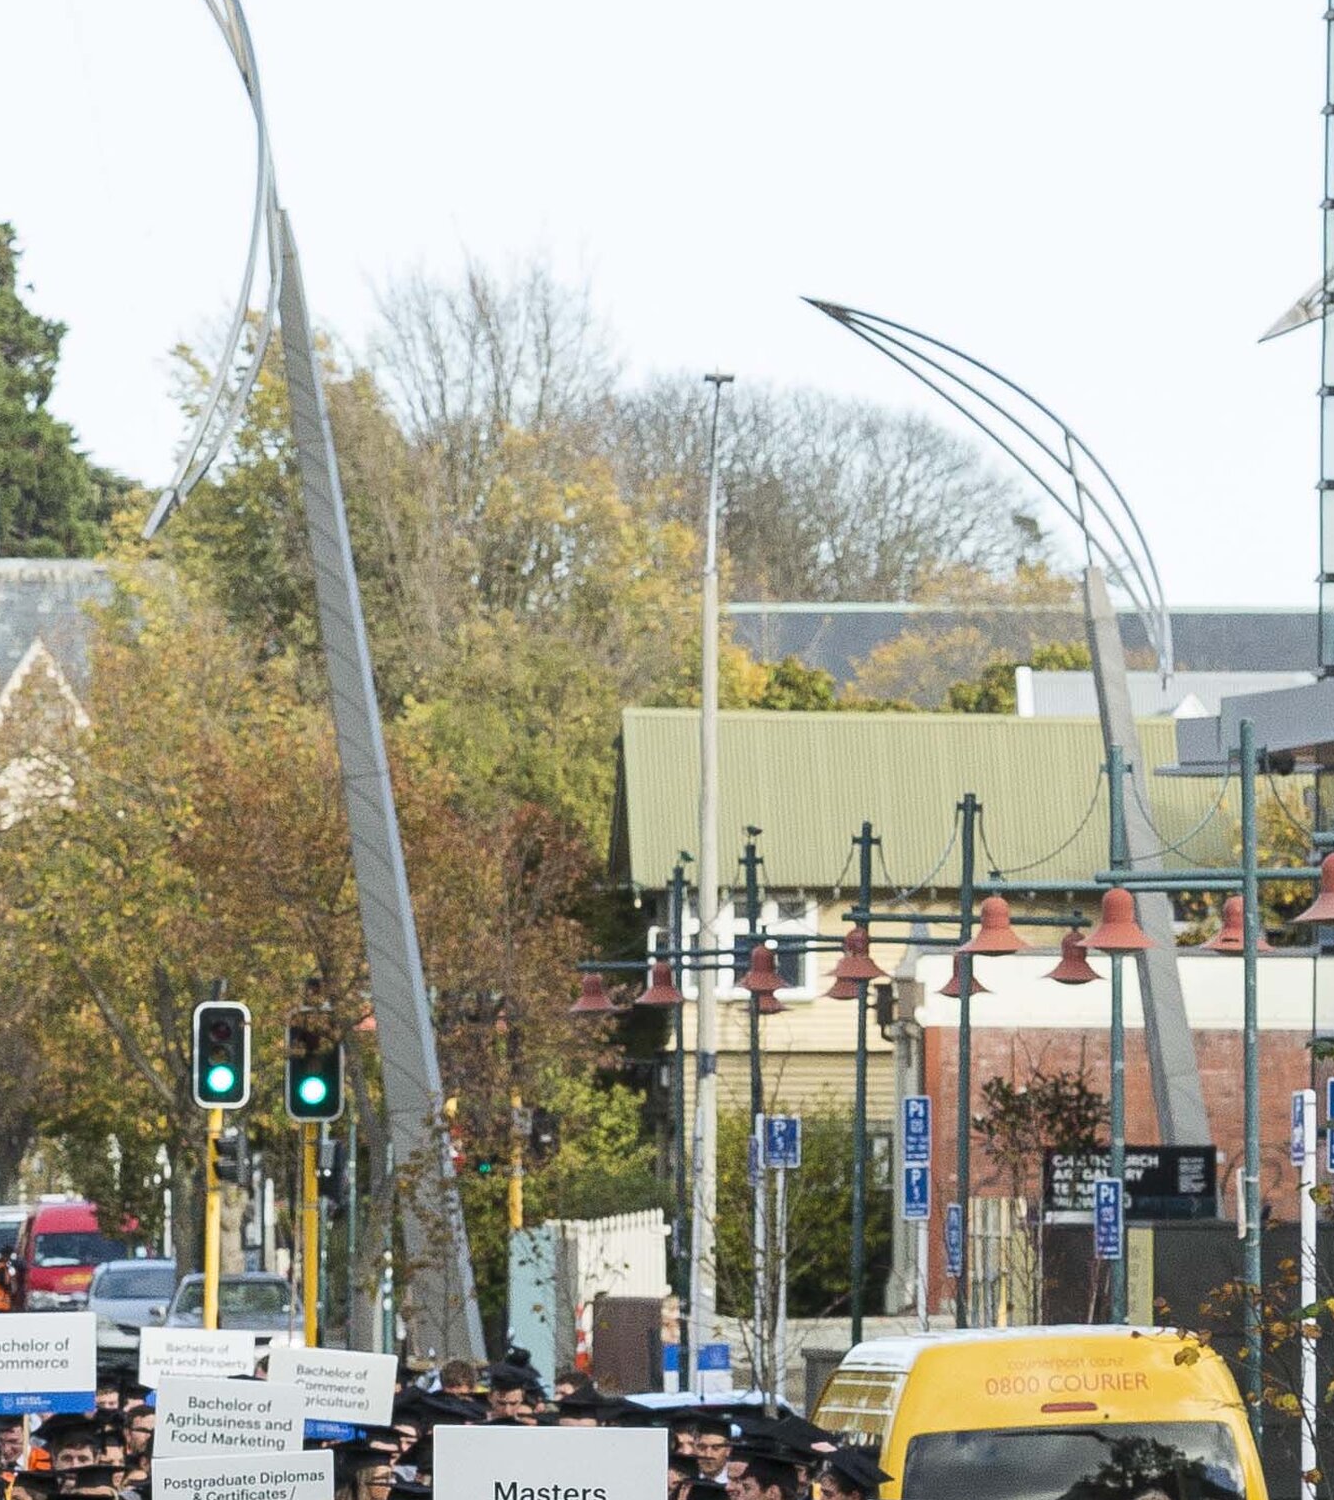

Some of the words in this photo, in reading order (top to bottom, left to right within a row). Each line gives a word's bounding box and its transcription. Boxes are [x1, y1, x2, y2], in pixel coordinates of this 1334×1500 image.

[55, 1338, 70, 1352] of
[296, 1363, 351, 1379] Bachelor
[355, 1369, 368, 1381] of
[985, 1375, 1041, 1396] 0800
[1047, 1371, 1150, 1394] COURIER
[188, 1396, 255, 1413] Bachelor
[257, 1399, 273, 1414] of
[165, 1411, 264, 1432] Agribusiness
[266, 1418, 293, 1432] and
[170, 1429, 208, 1445] Food
[211, 1432, 287, 1451] Marketing
[163, 1474, 257, 1491] Postgraduate
[259, 1470, 326, 1486] Diplomas
[289, 1486, 297, 1500] /
